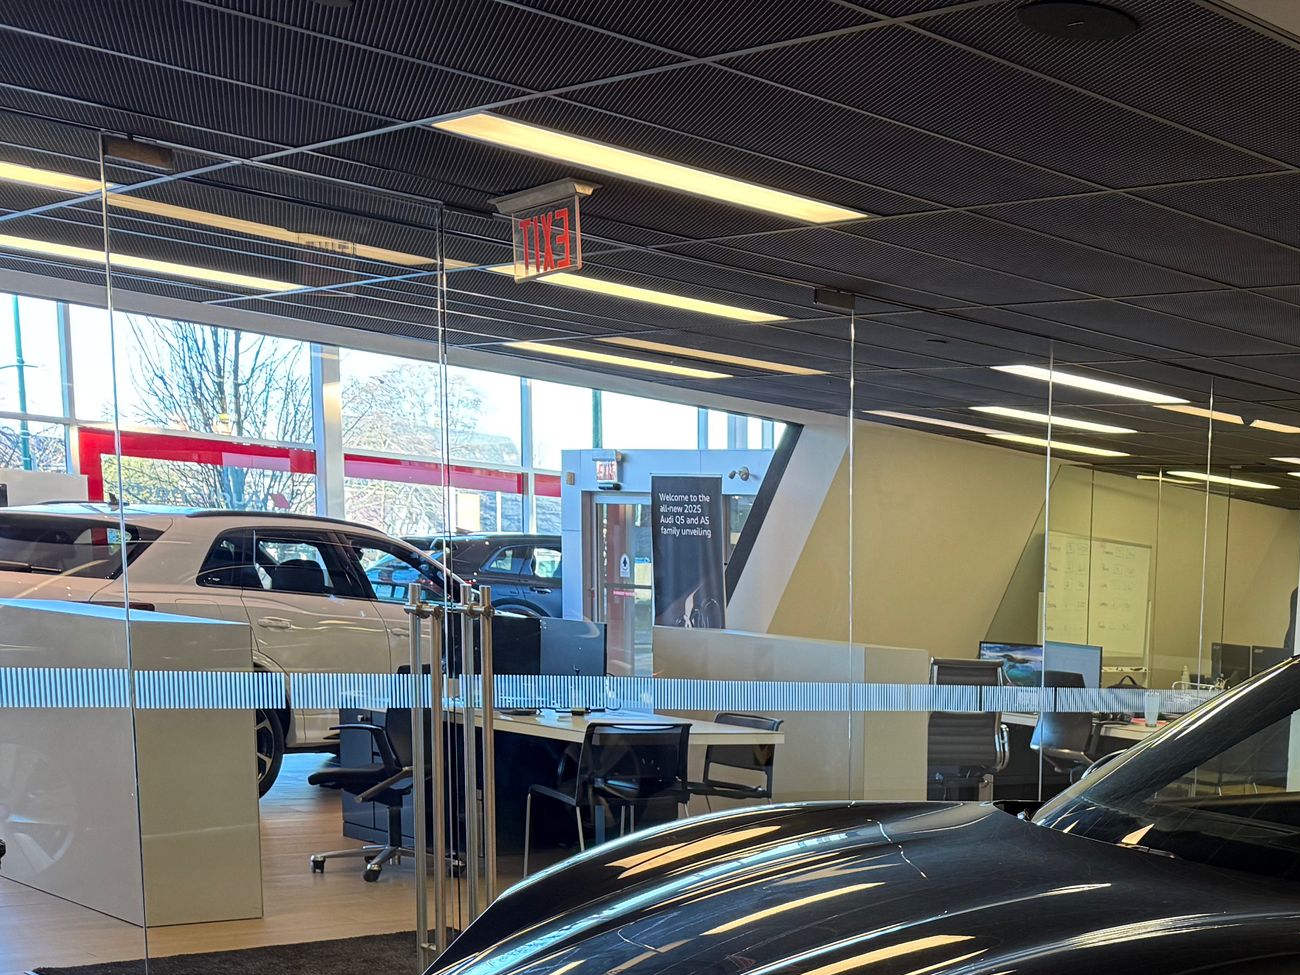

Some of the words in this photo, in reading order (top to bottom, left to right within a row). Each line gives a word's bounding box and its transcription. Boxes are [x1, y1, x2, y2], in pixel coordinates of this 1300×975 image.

[659, 493, 689, 502] Welcome
[699, 494, 710, 502] the
[660, 504, 683, 513] all-new
[684, 505, 702, 513] 2025
[660, 515, 674, 523] Audi
[675, 516, 685, 525] Q5
[686, 517, 699, 525] and
[700, 516, 710, 525] A5
[661, 526, 680, 537] family
[681, 527, 711, 539] unveiling
